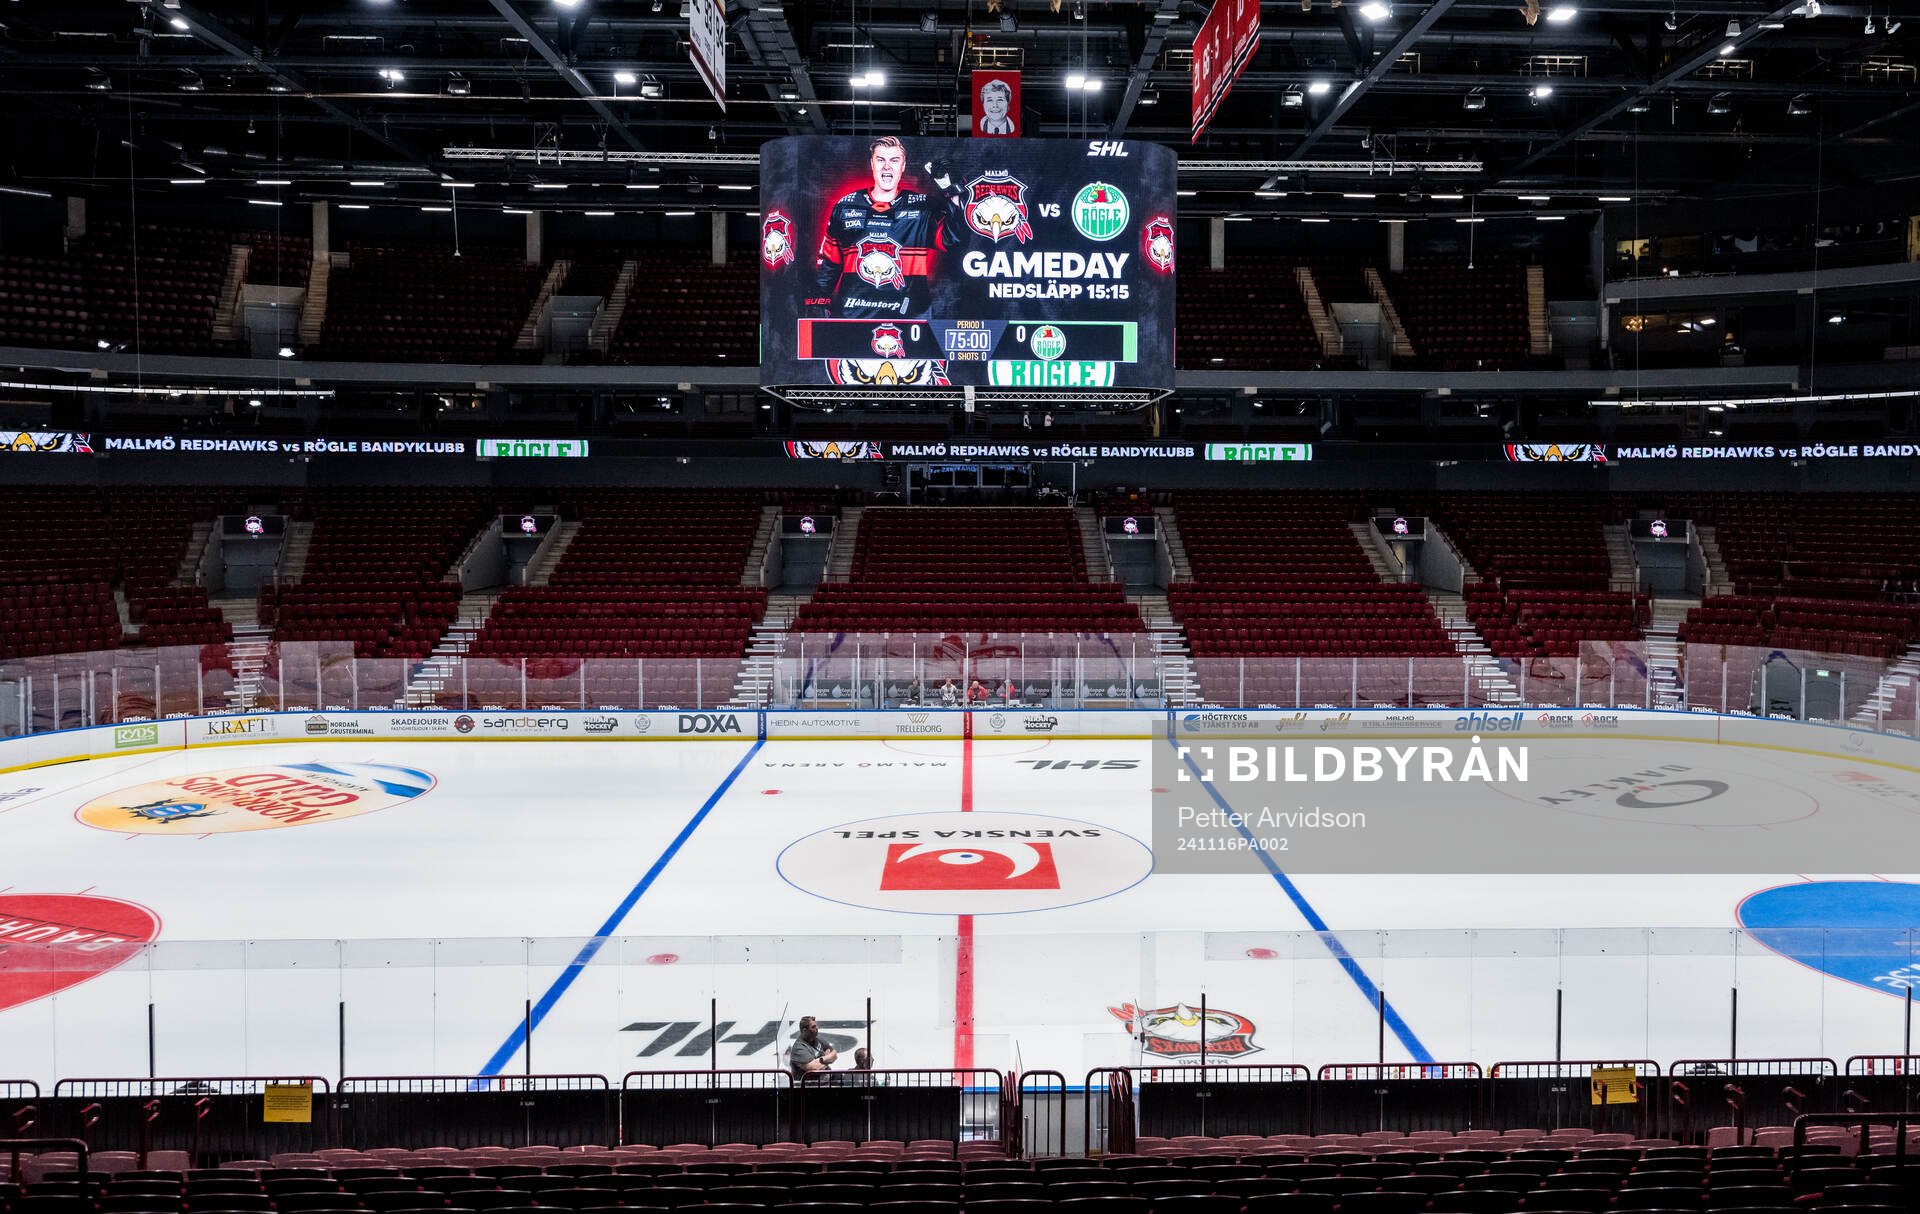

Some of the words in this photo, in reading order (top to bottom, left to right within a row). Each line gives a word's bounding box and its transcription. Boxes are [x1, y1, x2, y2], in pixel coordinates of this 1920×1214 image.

[1087, 141, 1128, 157] SHL
[985, 169, 1009, 177] MALMÖ
[975, 184, 1019, 201] REDHAWKS
[1082, 206, 1121, 236] RÖGLE
[962, 251, 1130, 279] GAMEDAY
[989, 280, 1082, 299] NEDSLÄPP
[1086, 284, 1130, 300] 15:15
[844, 297, 901, 311] Håkantorp
[957, 320, 980, 329] PERIOD
[981, 320, 985, 329] 1
[910, 324, 921, 342] 0
[949, 332, 988, 349] 75:00
[1016, 326, 1026, 343] 0
[949, 352, 955, 361] 0
[957, 352, 979, 361] SHOTS
[981, 352, 987, 361] 0
[105, 436, 175, 451] MALMÖ
[180, 439, 278, 452] REDHAWKS
[283, 443, 300, 453] vs
[304, 438, 358, 453] RÖGLE
[362, 441, 465, 454] BANDYKLUBB
[892, 443, 946, 456] MALMÖ
[950, 445, 1029, 456] REDHAWKS
[1033, 448, 1048, 456] vs
[1051, 444, 1098, 457] RÖGLE
[1101, 446, 1195, 457] BANDYKLUBB
[1617, 444, 1677, 458] MALMÖ
[1682, 446, 1775, 458] REDHAWKS
[1779, 449, 1797, 458] vs
[1801, 443, 1859, 457] RÖGLE
[208, 718, 268, 735] KRAFT
[330, 720, 358, 728] NORDANÅ
[391, 718, 449, 726] SKADEJOUREN
[483, 717, 569, 730] sandberg
[679, 714, 742, 733] DOXA
[1454, 712, 1524, 731] ahlsell
[1550, 715, 1573, 724] ROCK
[1593, 715, 1618, 724] ROCK
[118, 726, 155, 740] RYDS
[896, 725, 942, 733] TRELLEBORG
[1016, 759, 1142, 770] SHL
[226, 774, 359, 808] GULD
[1538, 764, 1692, 805] OAKLEY
[165, 777, 333, 824] NORRLANDS
[833, 830, 920, 839] SPEL
[934, 830, 1101, 838] SVENSKA
[1153, 1037, 1245, 1053] REDAWKS
